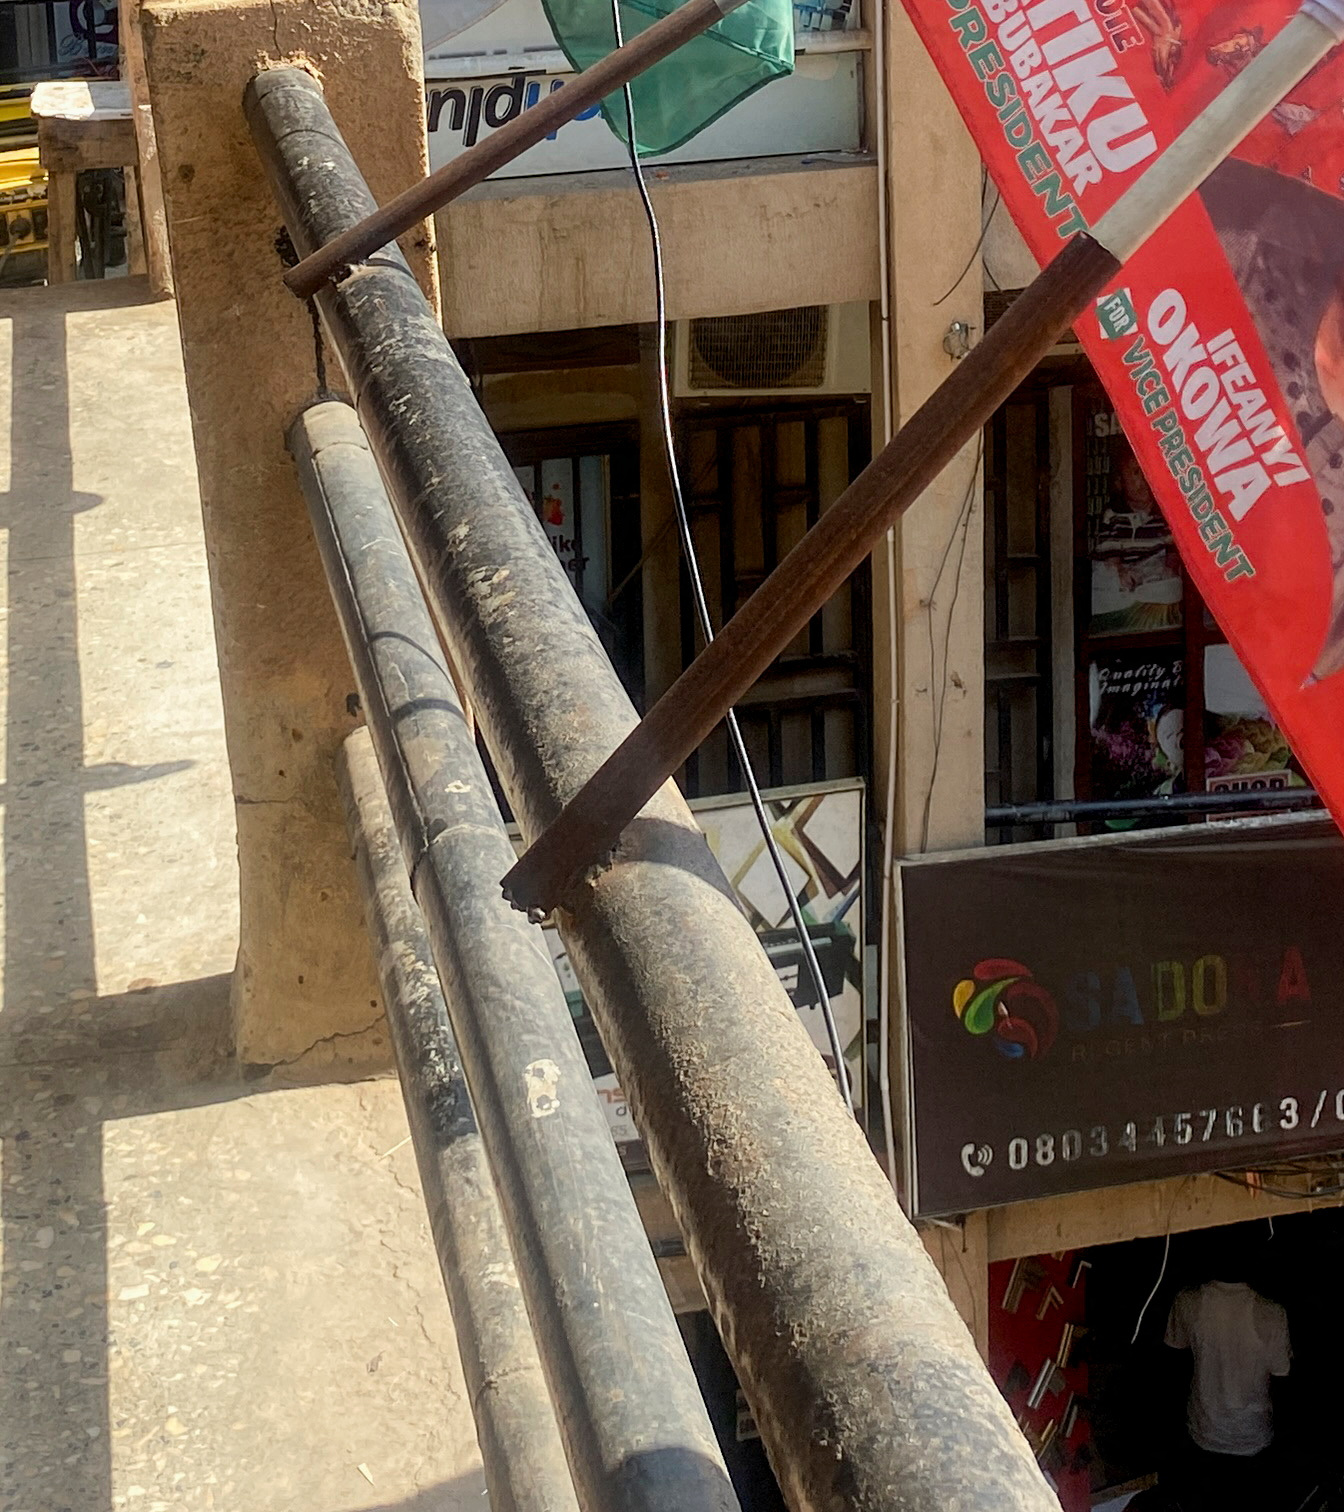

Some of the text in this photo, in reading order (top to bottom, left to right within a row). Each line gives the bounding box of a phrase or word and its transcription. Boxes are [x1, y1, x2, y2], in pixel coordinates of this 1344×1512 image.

[1104, 294, 1256, 583] FOR VICE PRESIDENT
[1146, 288, 1270, 521] OKOWA
[1207, 328, 1309, 487] IFEANYI
[1098, 662, 1166, 683] Quality
